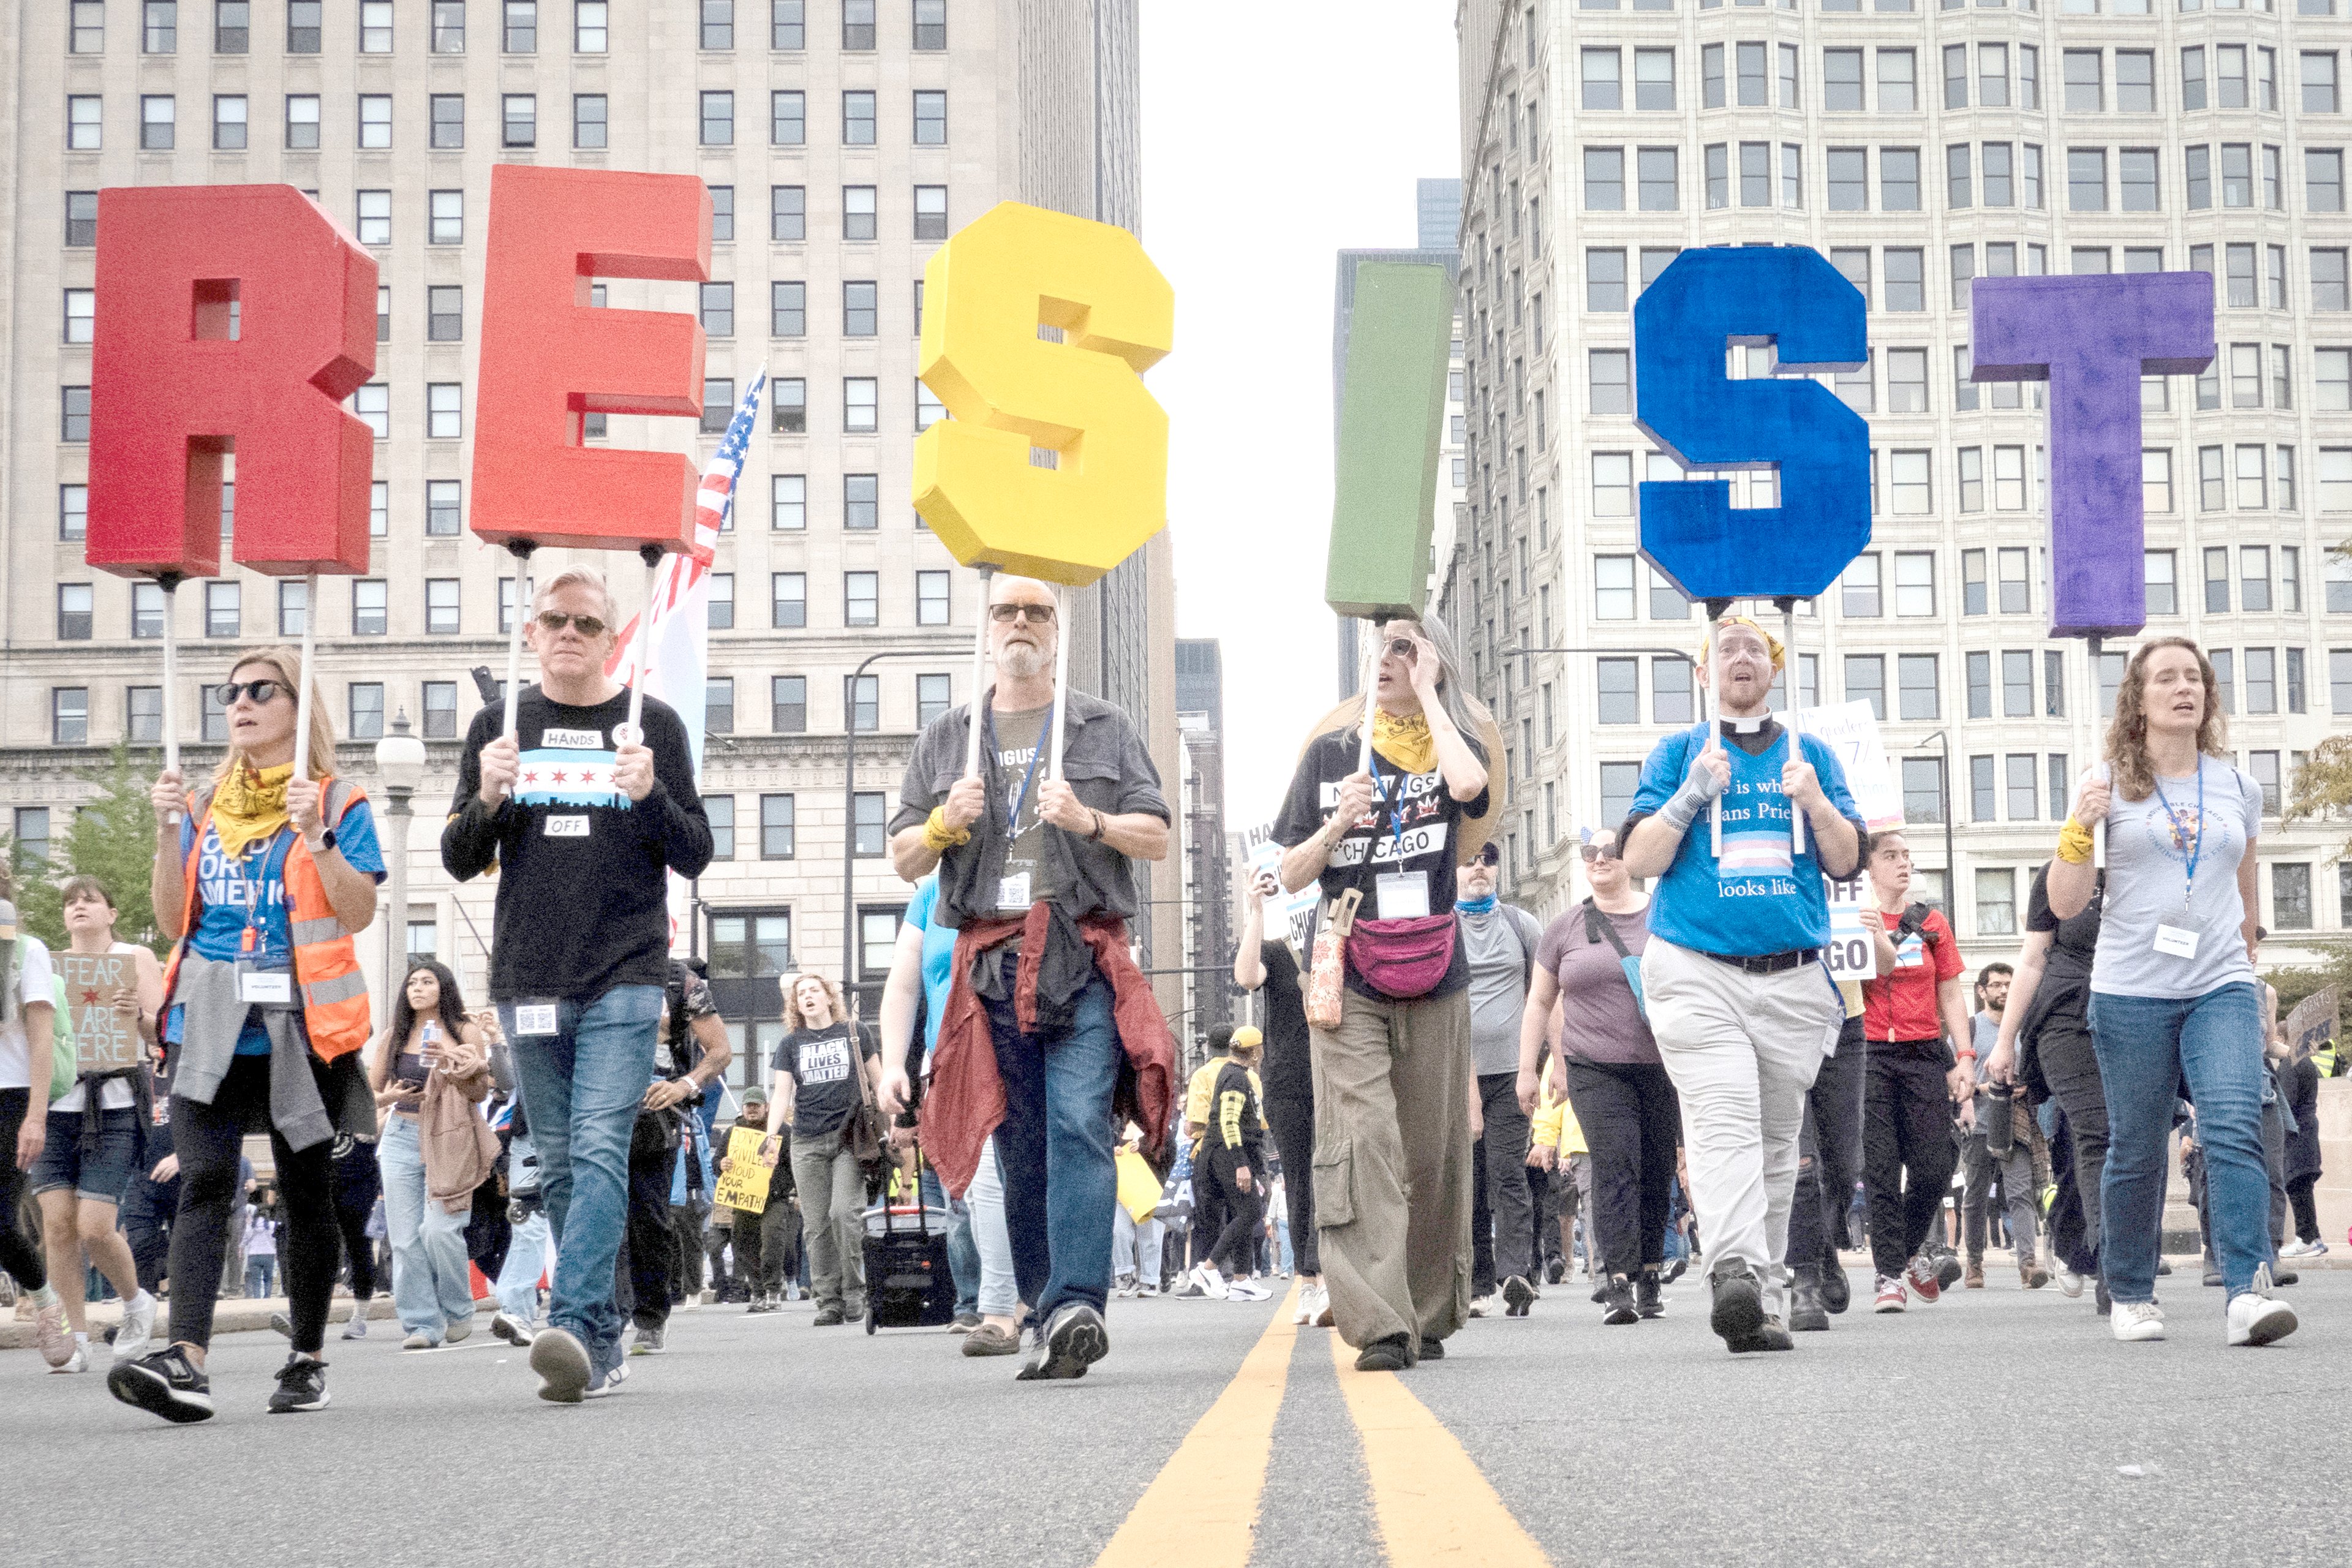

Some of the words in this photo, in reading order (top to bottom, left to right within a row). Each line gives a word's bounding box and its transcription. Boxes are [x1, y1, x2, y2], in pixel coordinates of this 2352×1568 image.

[548, 732, 595, 745] HANDS
[1373, 776, 1435, 797] KIGS
[1736, 779, 1750, 794] is
[1756, 778, 1782, 793] wh
[1702, 807, 1751, 823] Tans
[1758, 802, 1792, 819] Prie
[2188, 802, 2223, 823] CHCAGO
[551, 820, 582, 833] OFF
[1343, 831, 1430, 862] CHCAGO
[1717, 880, 1766, 898] looks
[1772, 878, 1797, 895] like
[1823, 939, 1868, 972] GO
[63, 956, 126, 989] FEAR
[81, 1005, 128, 1035] ARE
[77, 1033, 129, 1062] ERE
[802, 1040, 846, 1058] BLACK
[808, 1053, 841, 1068] LIVES
[802, 1065, 848, 1083] MATTER
[729, 1145, 769, 1168] PRIVILE
[722, 1175, 743, 1188] YOUR
[717, 1187, 767, 1211] EMPATHY
